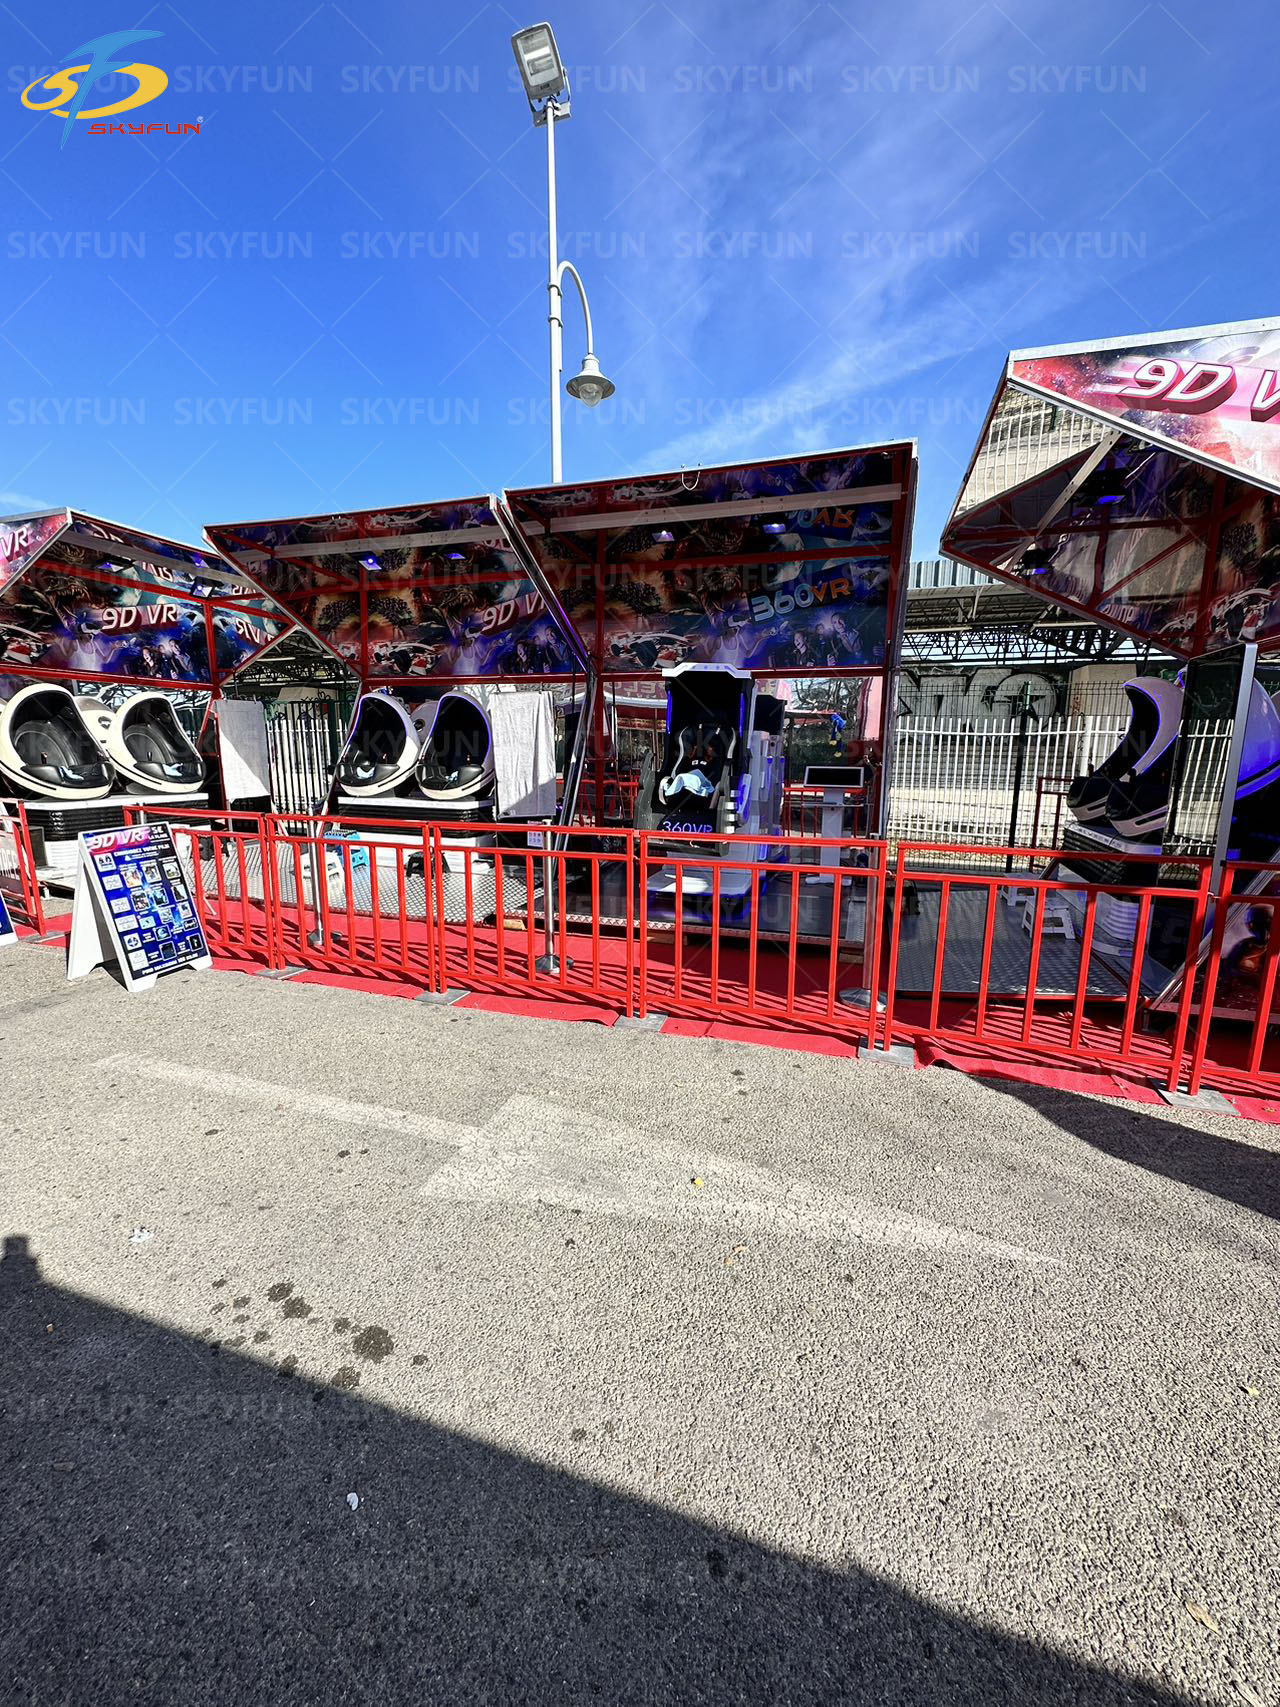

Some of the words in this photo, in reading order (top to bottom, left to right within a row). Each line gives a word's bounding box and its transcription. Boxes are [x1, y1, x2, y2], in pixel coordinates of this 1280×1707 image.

[1120, 359, 1236, 407] 9D
[101, 607, 138, 630] 9D
[147, 603, 179, 625] VR
[481, 599, 516, 632] 9D
[751, 576, 851, 622] 360VR
